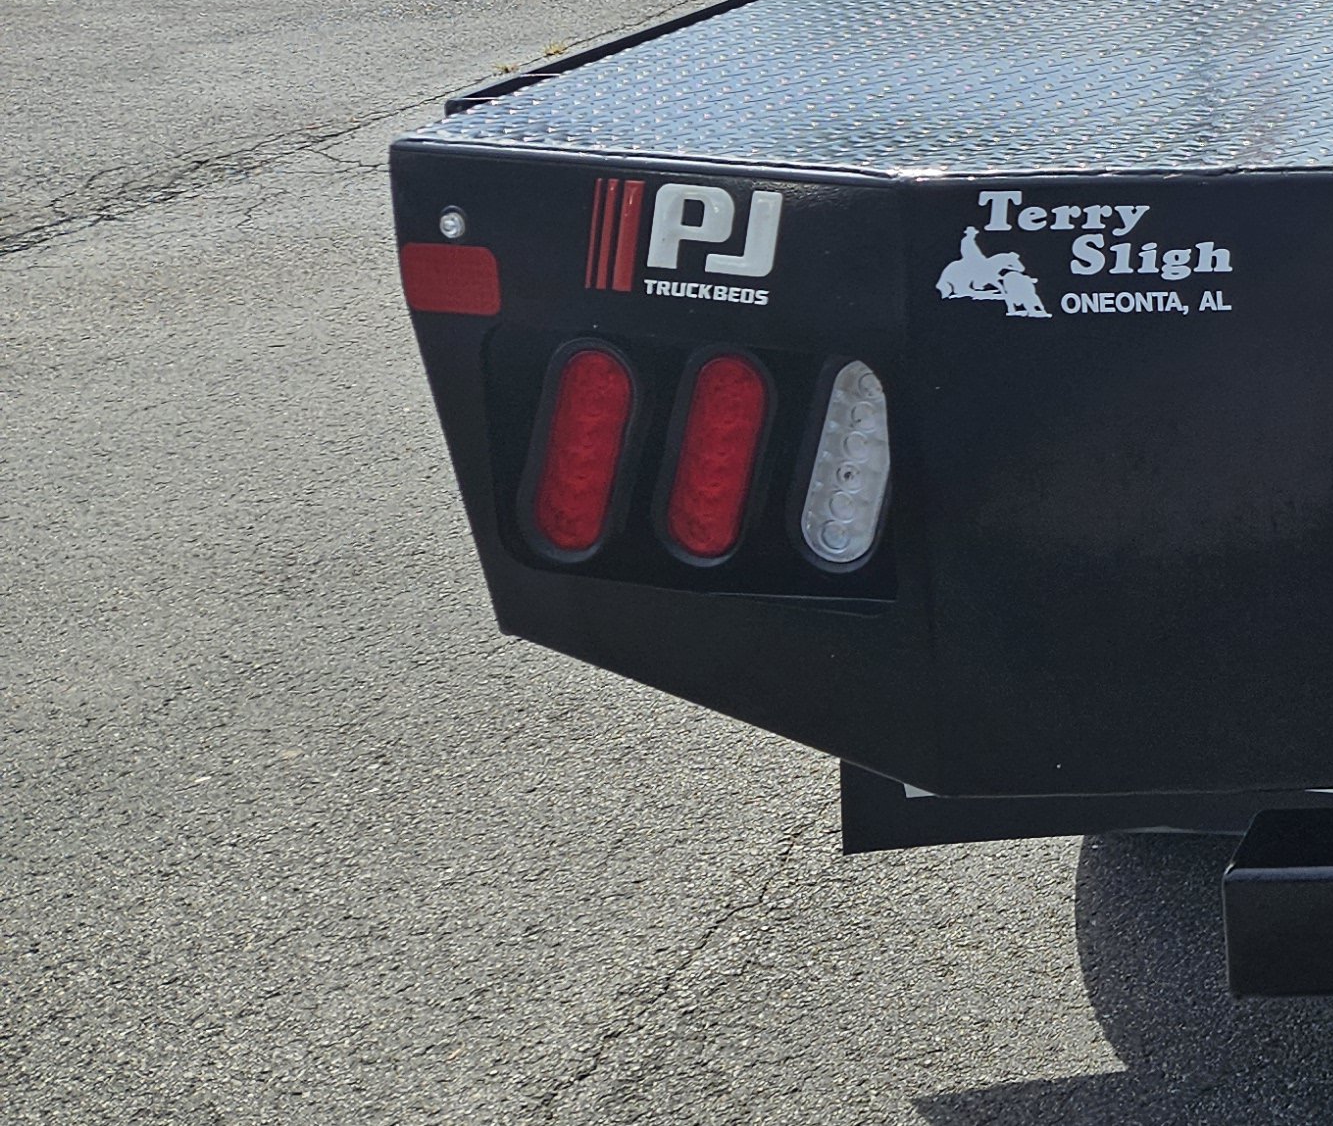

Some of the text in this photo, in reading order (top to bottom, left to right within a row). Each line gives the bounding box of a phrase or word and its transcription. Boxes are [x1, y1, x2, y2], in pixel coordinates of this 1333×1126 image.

[646, 183, 784, 278] PJ
[977, 190, 1151, 237] Terry
[1069, 233, 1234, 281] Sligh
[643, 278, 770, 306] TRUCKBEDS
[1060, 290, 1233, 315] ONEONTA, AL
